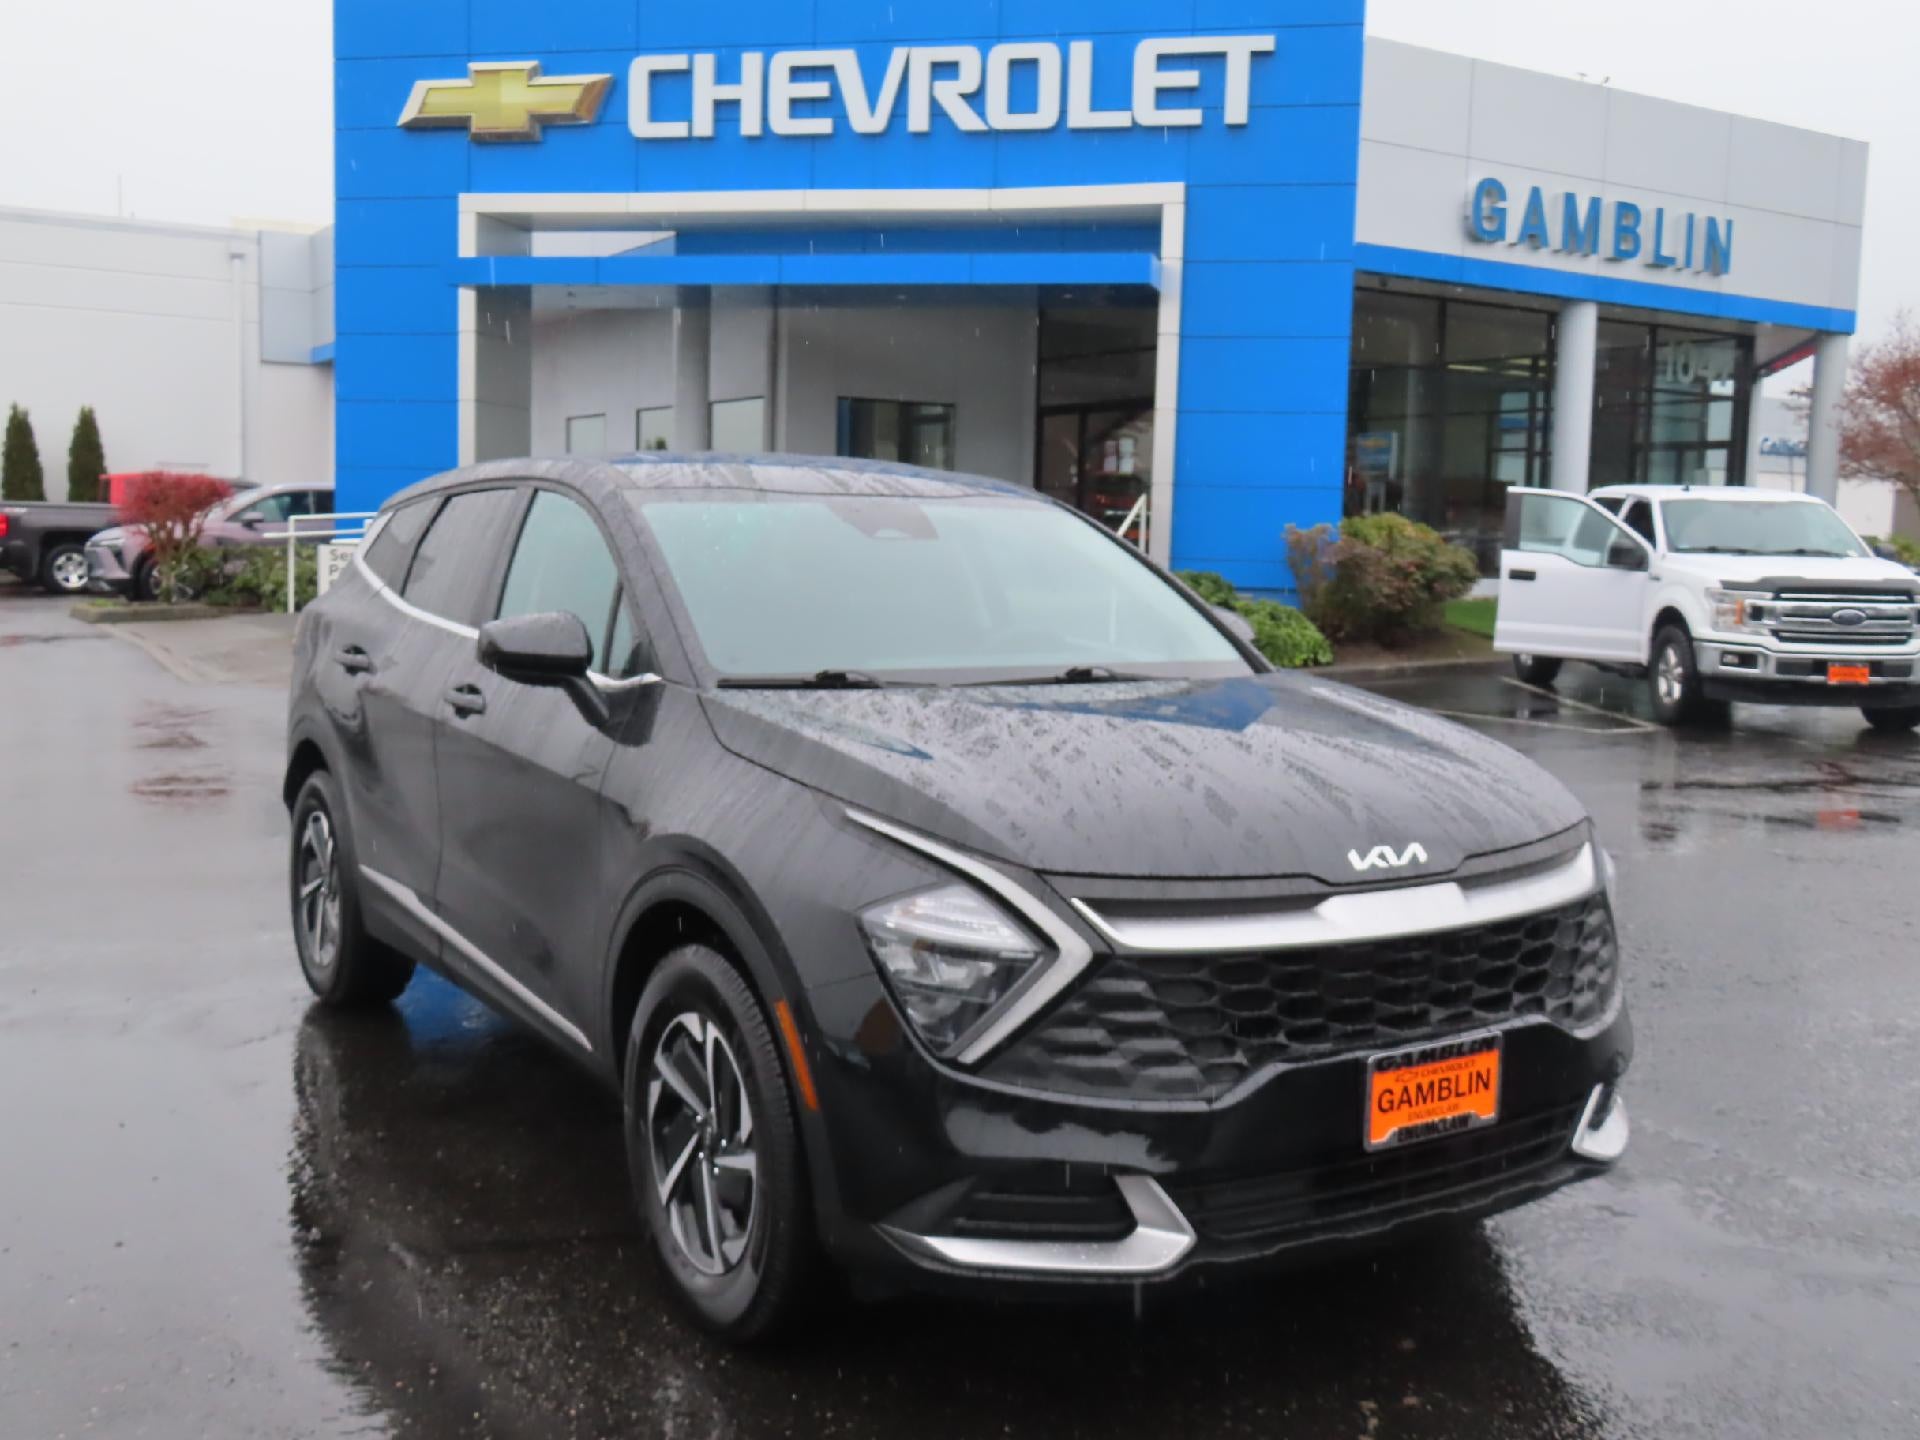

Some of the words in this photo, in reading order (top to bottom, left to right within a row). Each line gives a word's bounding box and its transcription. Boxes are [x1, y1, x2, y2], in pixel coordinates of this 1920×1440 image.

[628, 35, 1276, 137] CHEVROLET
[1471, 177, 1733, 275] GAMBLIN
[1347, 842, 1428, 871] KIA
[1377, 1067, 1491, 1113] GAMBLIN
